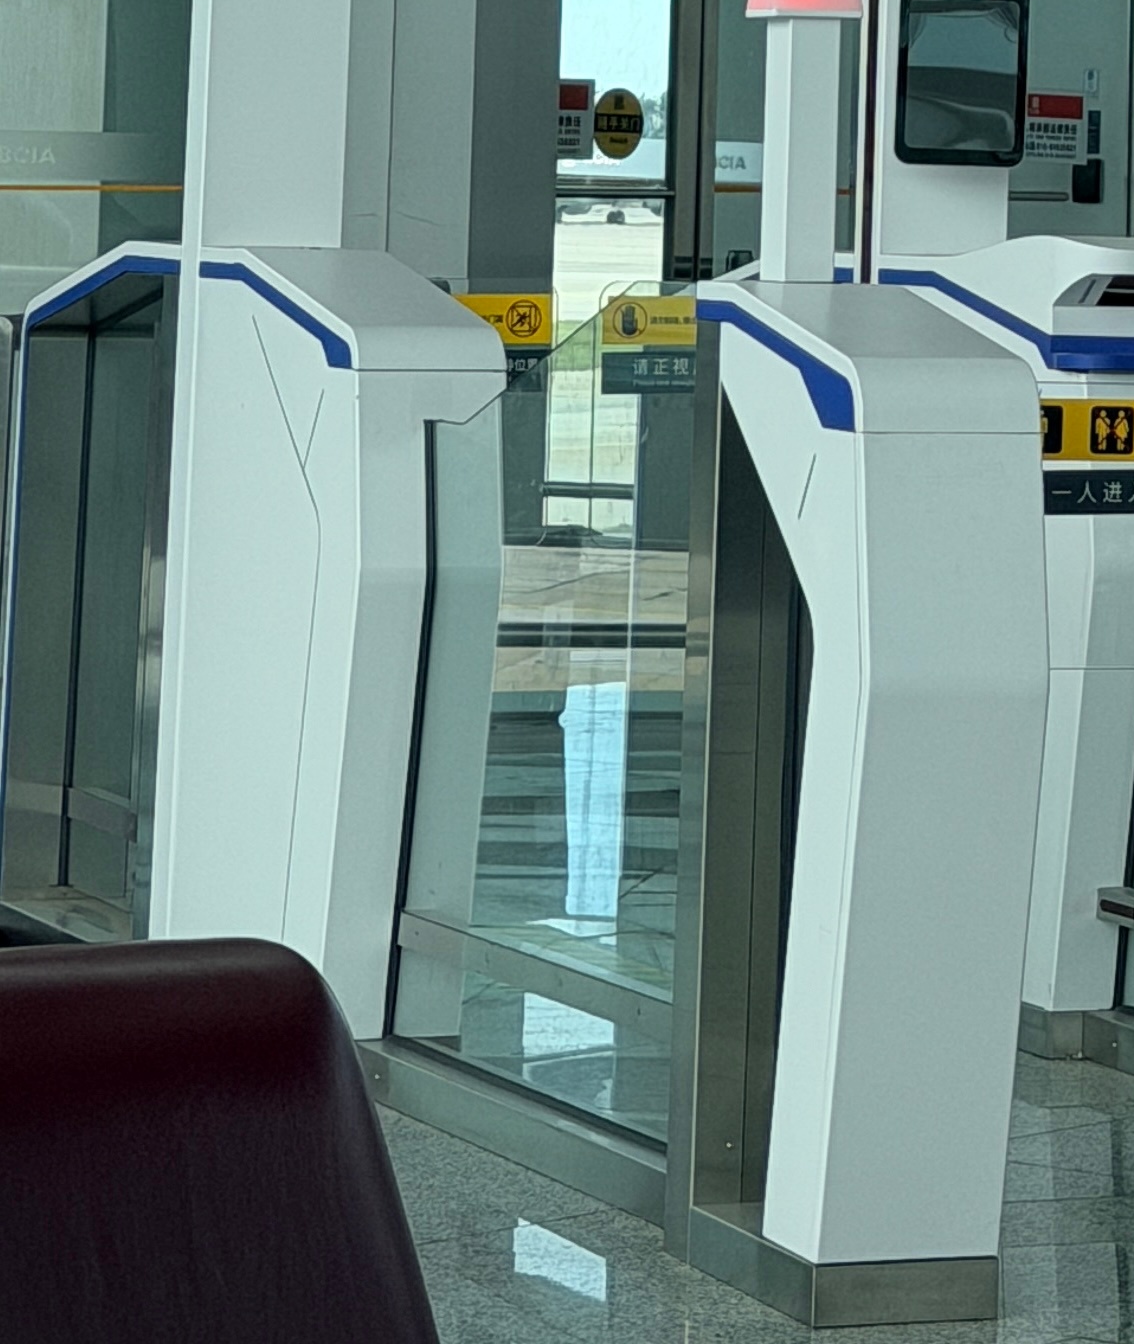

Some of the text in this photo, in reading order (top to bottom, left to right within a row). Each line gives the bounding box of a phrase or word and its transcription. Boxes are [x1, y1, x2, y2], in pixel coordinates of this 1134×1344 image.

[715, 155, 747, 171] CIA
[634, 357, 697, 376] 请正视
